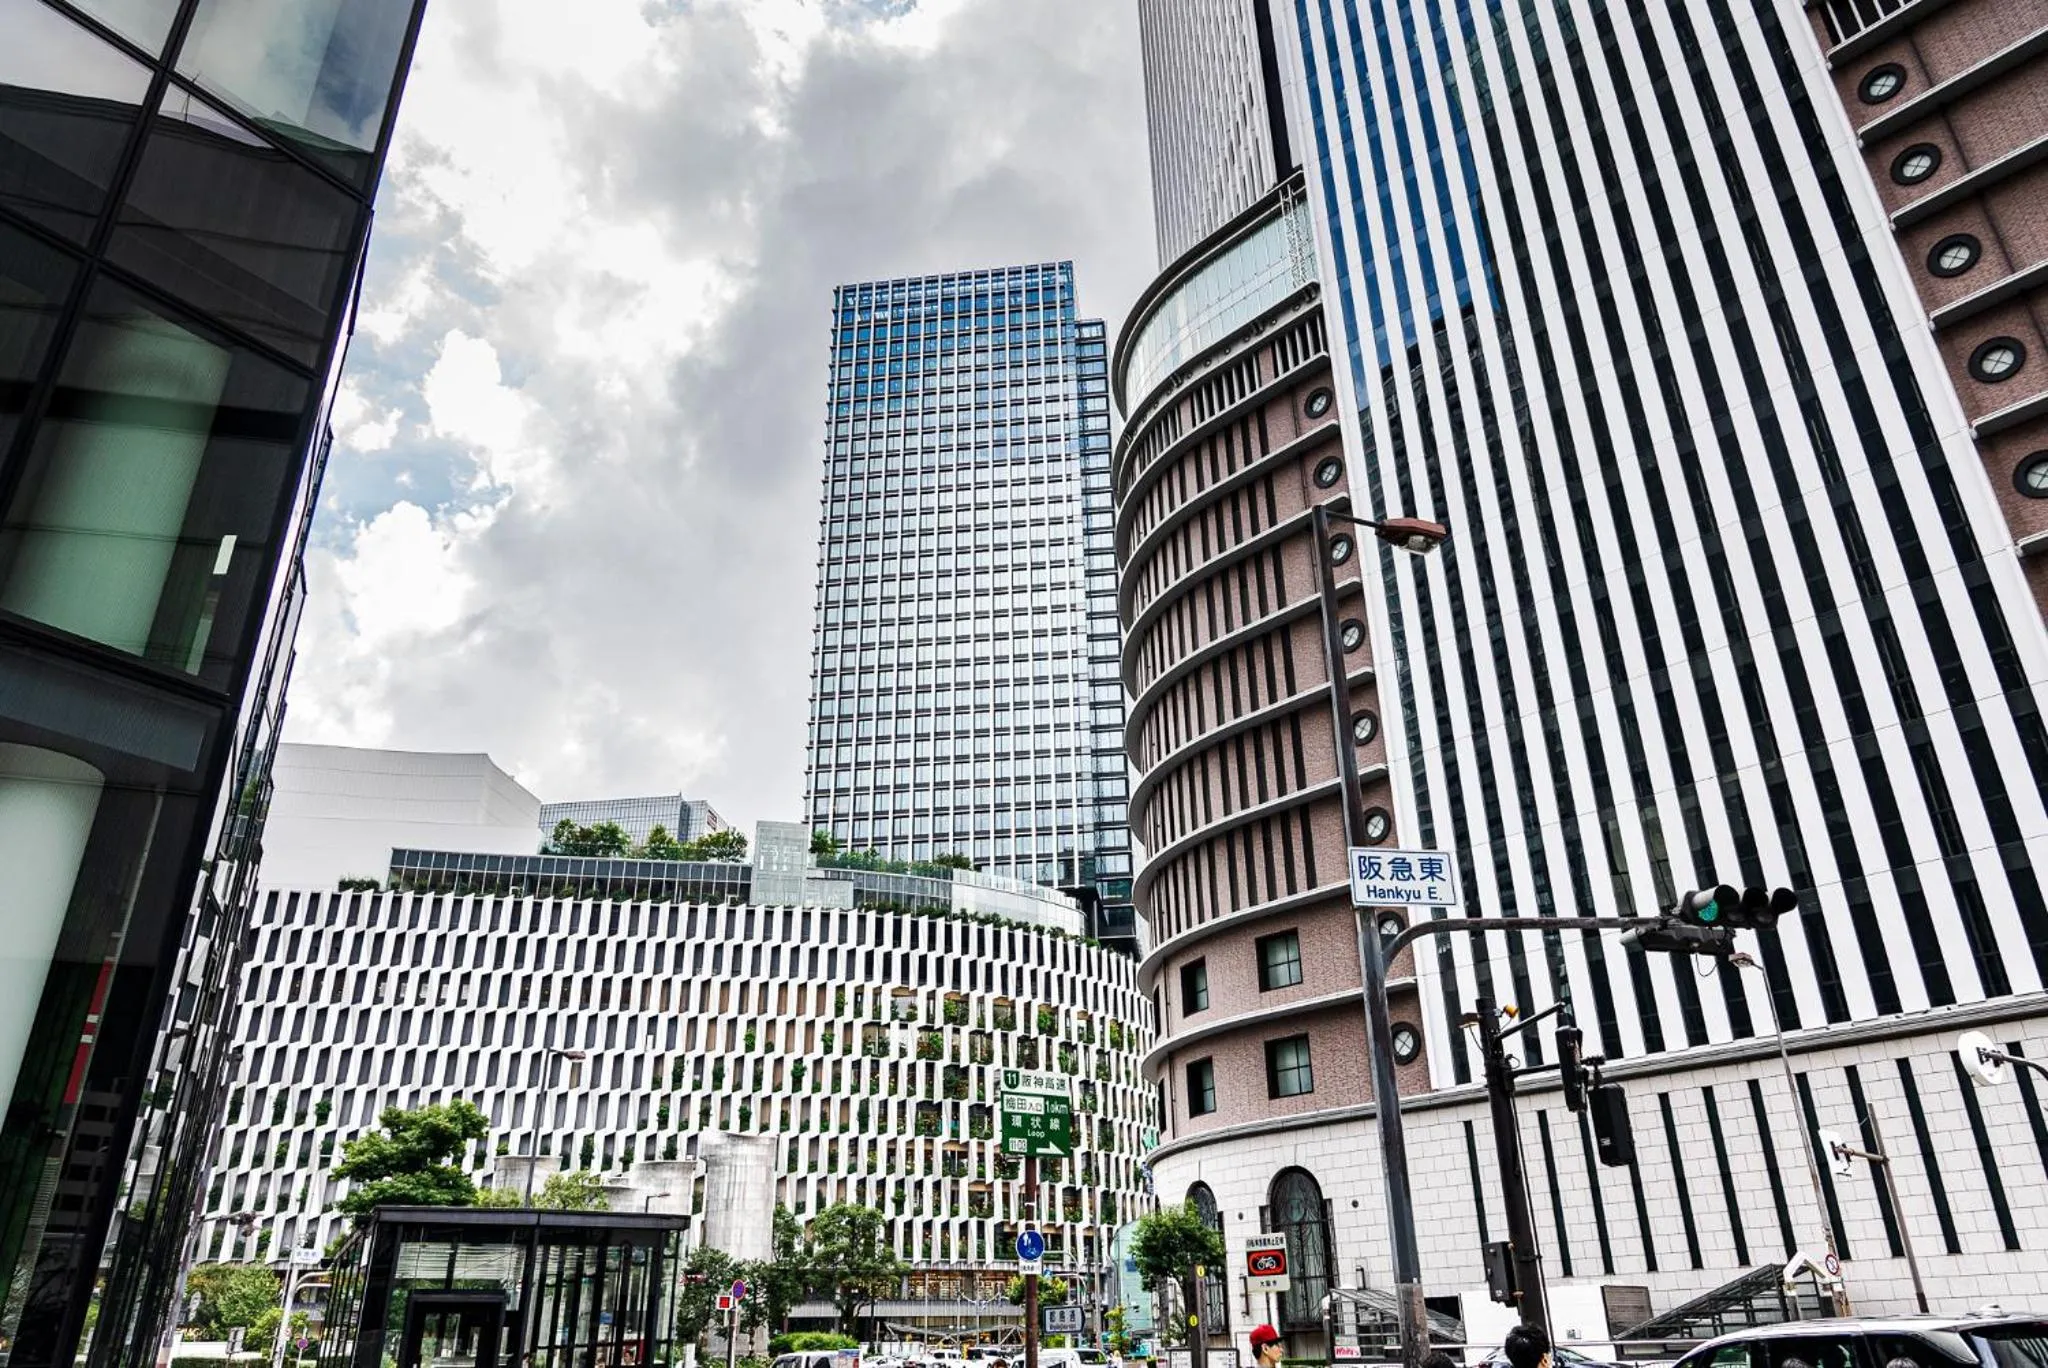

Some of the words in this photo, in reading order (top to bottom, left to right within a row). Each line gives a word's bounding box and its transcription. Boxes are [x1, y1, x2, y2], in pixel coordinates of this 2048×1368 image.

[1358, 855, 1447, 882] 阪急東
[1366, 885, 1421, 902] Hankyu
[1427, 886, 1443, 901] E.
[1006, 1072, 1017, 1085] 11
[1022, 1074, 1066, 1091] 阪神高速
[1011, 1114, 1060, 1131] 環状線
[1027, 1129, 1046, 1138] Loop
